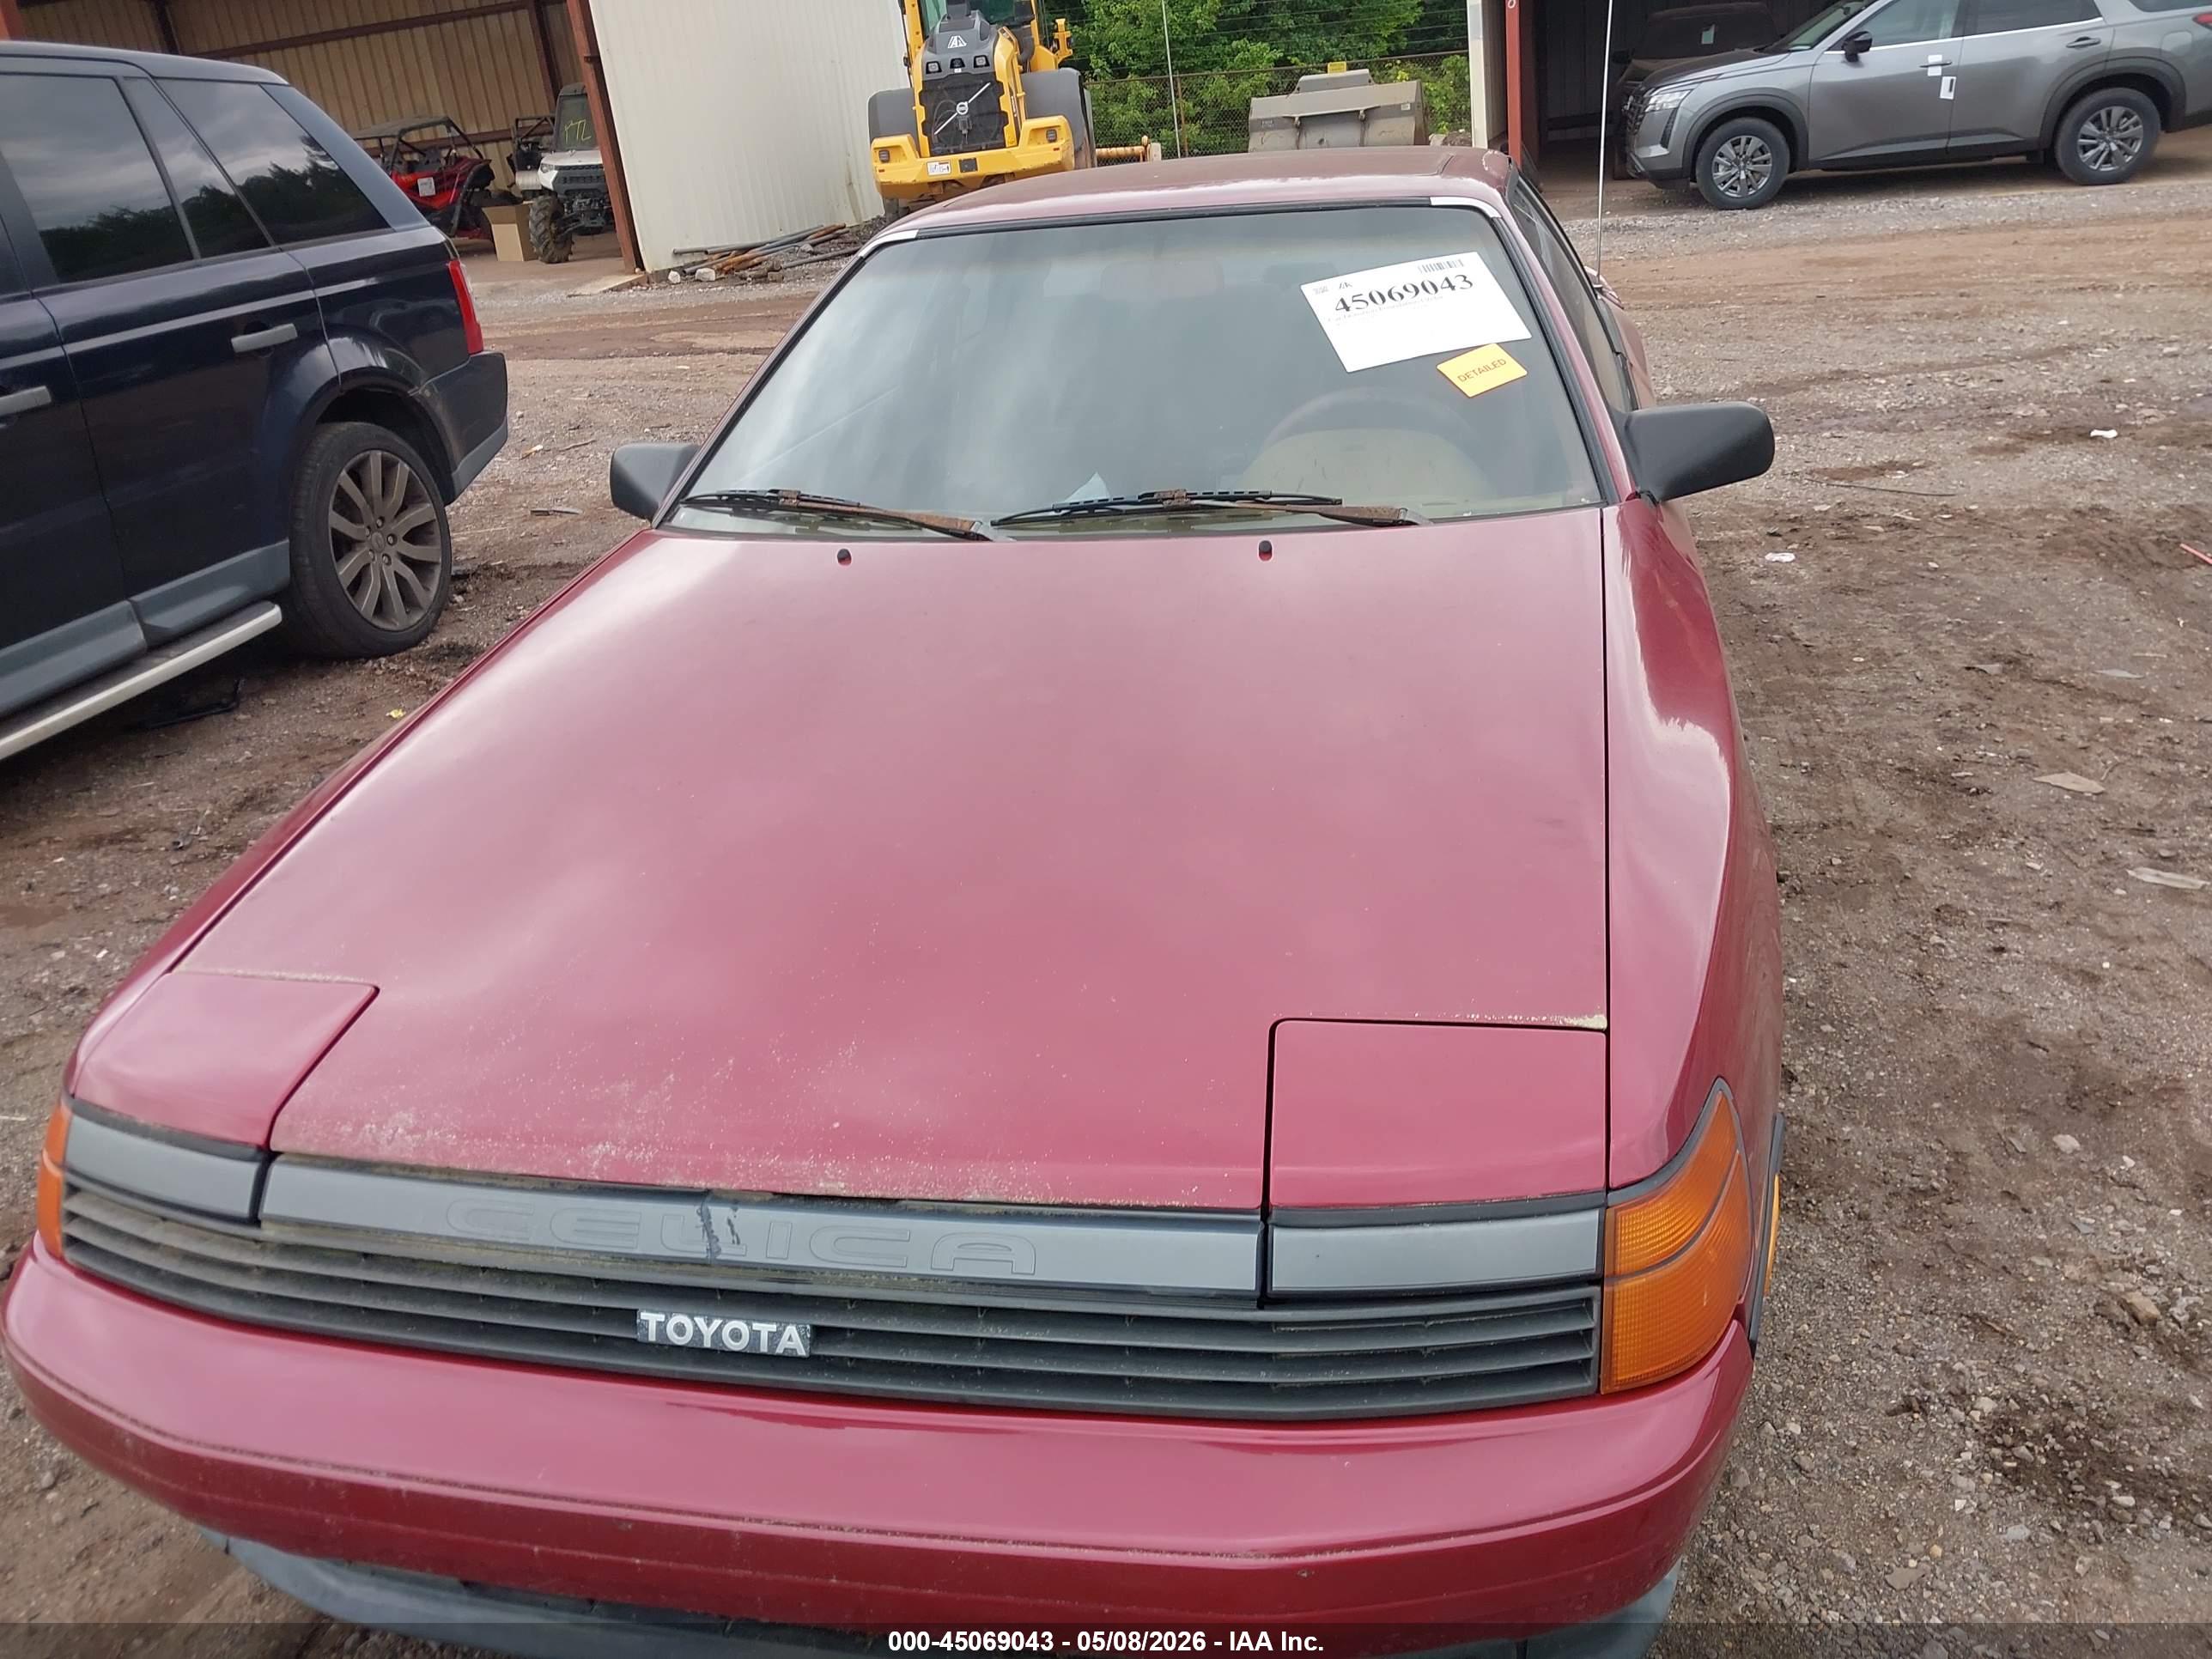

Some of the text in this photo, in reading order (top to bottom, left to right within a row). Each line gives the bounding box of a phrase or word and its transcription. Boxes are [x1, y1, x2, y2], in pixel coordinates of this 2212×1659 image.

[1334, 274, 1474, 313] 45069043
[1457, 358, 1507, 383] DETAILED
[446, 1197, 1036, 1276] CELICA
[640, 1311, 806, 1357] TOYOTA
